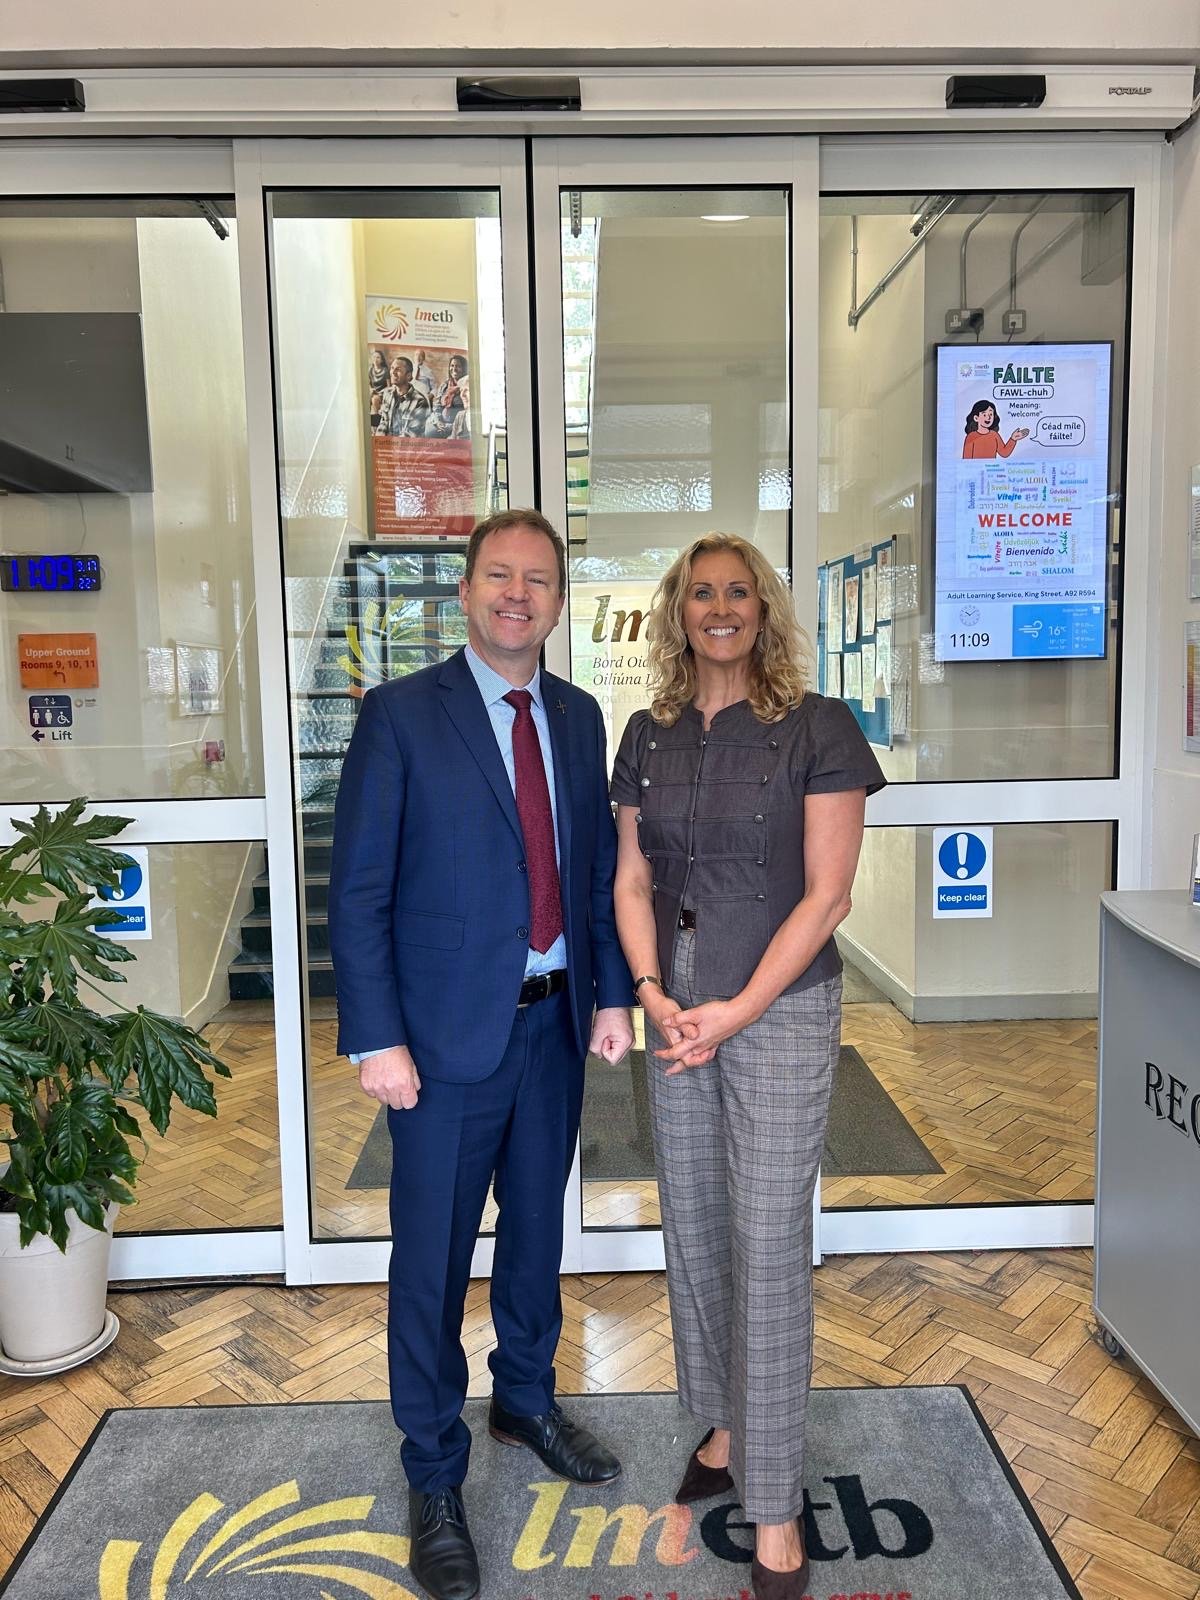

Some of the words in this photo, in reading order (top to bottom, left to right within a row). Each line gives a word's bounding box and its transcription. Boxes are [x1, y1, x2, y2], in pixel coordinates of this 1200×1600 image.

[414, 307, 454, 323] lmetb
[993, 363, 1055, 384] FÁILTE
[1000, 388, 1048, 397] FAWL-chuh
[1009, 402, 1041, 410] Meaning:
[1041, 422, 1062, 430] Céad
[1049, 432, 1073, 440] fáilte!
[977, 512, 1072, 528] WELCOME
[1005, 546, 1055, 556] Bienvenido
[11, 556, 75, 591] 11:09
[1041, 567, 1074, 575] SHALOM
[947, 592, 965, 600] Adult
[966, 591, 996, 600] Learning
[1024, 590, 1040, 599] King
[950, 632, 990, 648] 11:09
[25, 648, 54, 659] Upper
[55, 647, 91, 657] Ground
[20, 660, 54, 670] Rooms
[55, 660, 65, 670] 9,
[67, 659, 82, 669] 10,
[85, 659, 95, 668] 11
[592, 655, 624, 669] Bord
[593, 672, 642, 686] Oiliúna
[51, 730, 73, 741] Lift
[940, 893, 962, 903] Keep
[964, 892, 986, 902] clear
